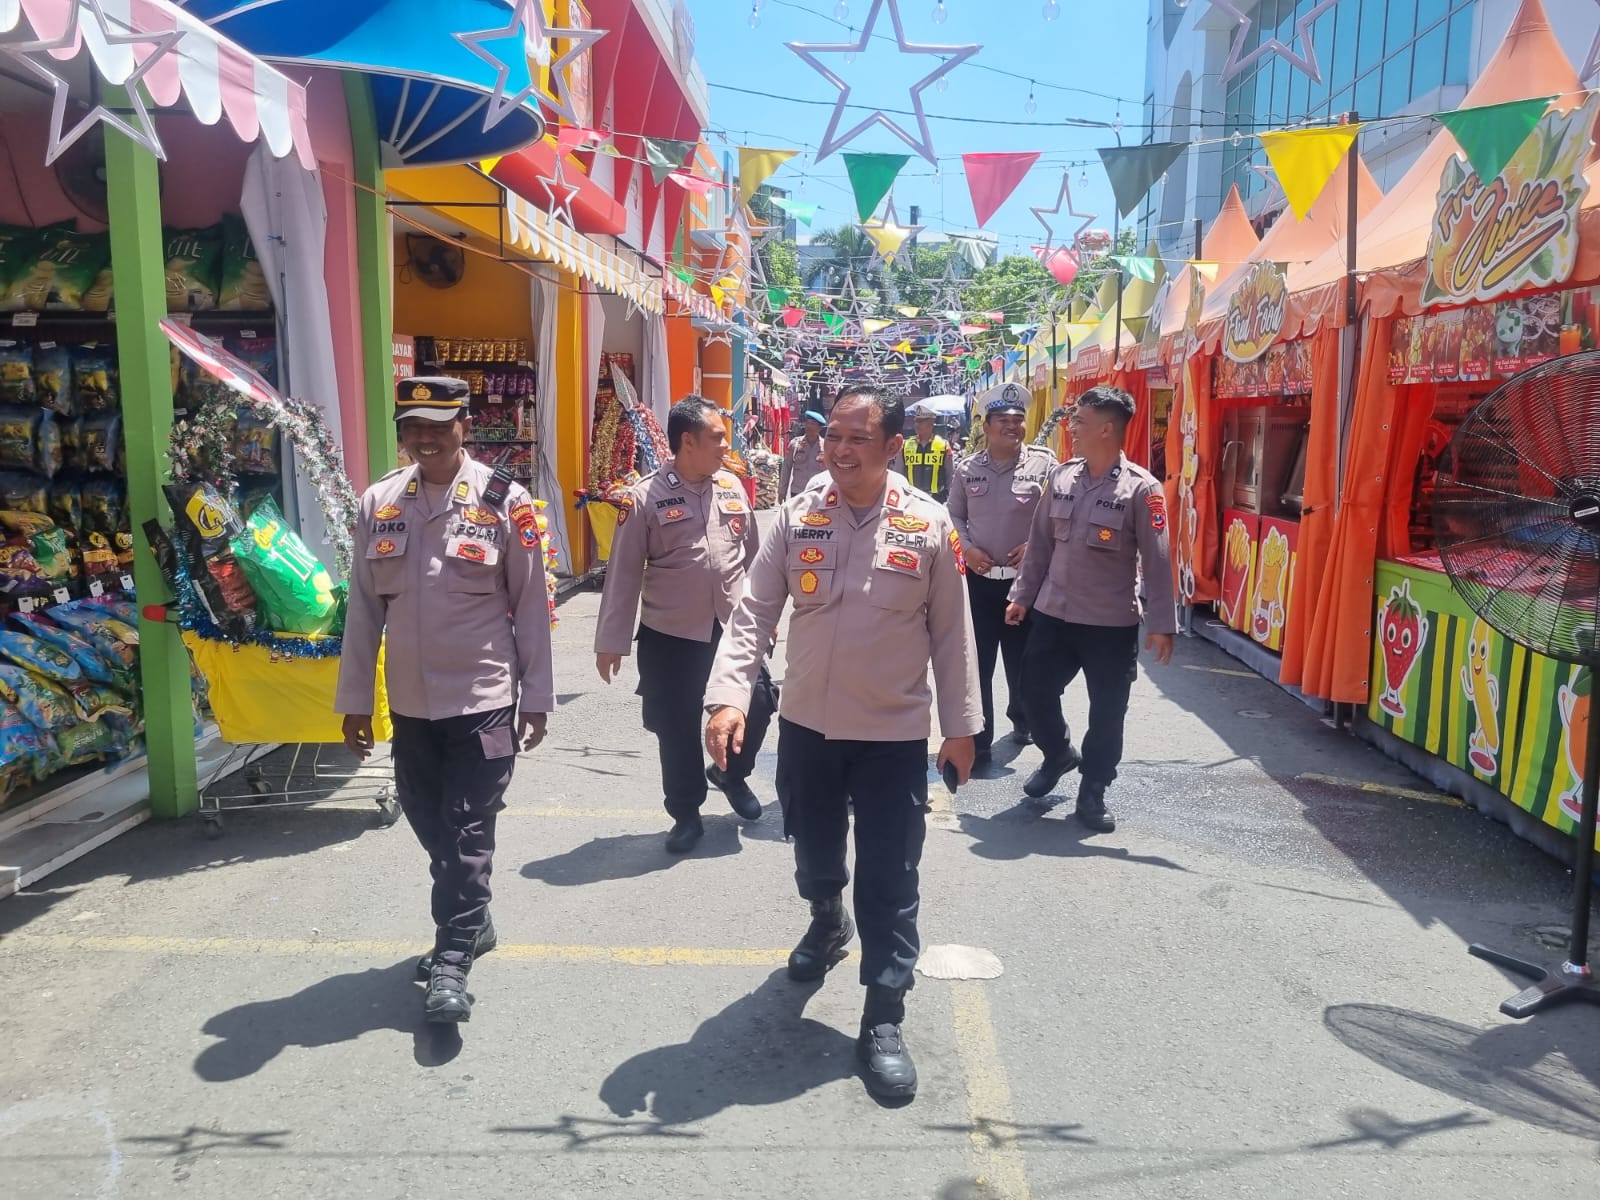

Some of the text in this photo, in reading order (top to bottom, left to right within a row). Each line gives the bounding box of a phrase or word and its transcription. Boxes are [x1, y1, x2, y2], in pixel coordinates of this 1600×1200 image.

[1454, 176, 1565, 291] Juice
[1254, 291, 1285, 339] Food
[400, 363, 413, 377] SINI
[1096, 499, 1126, 511] POLRI
[456, 522, 498, 542] POLRI
[794, 528, 834, 540] HERRY
[885, 531, 928, 548] POLRI
